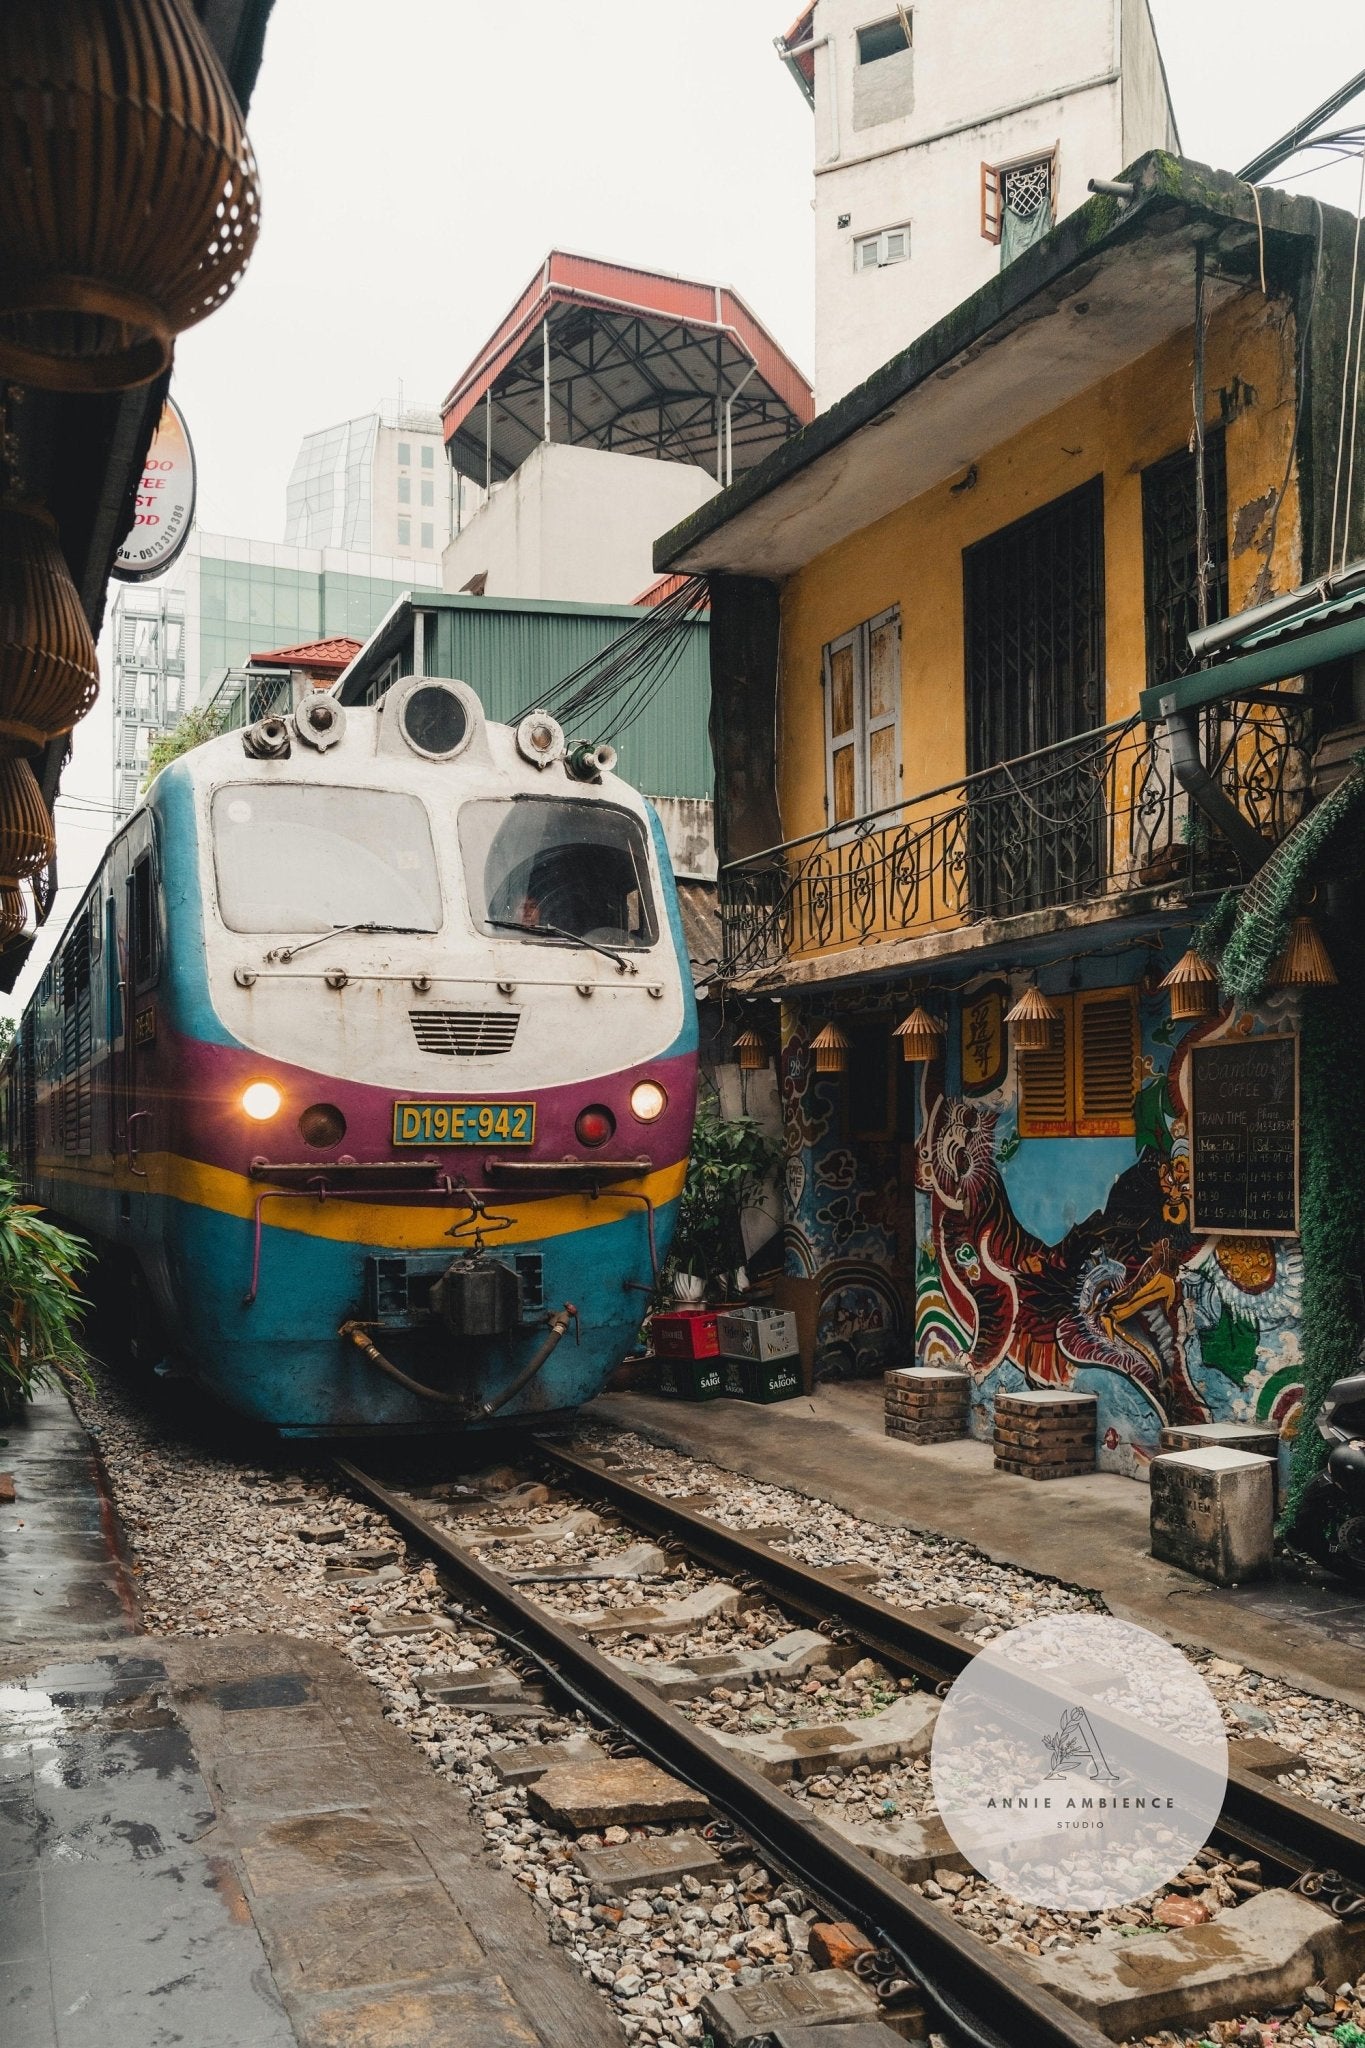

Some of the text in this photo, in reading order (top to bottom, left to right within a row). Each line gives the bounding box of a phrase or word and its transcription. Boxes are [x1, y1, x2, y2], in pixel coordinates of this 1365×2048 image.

[161, 525, 177, 544] 318
[170, 505, 185, 525] 389
[402, 1107, 527, 1139] D19E-942
[789, 1176, 802, 1188] ME
[768, 1376, 797, 1390] SAIGON
